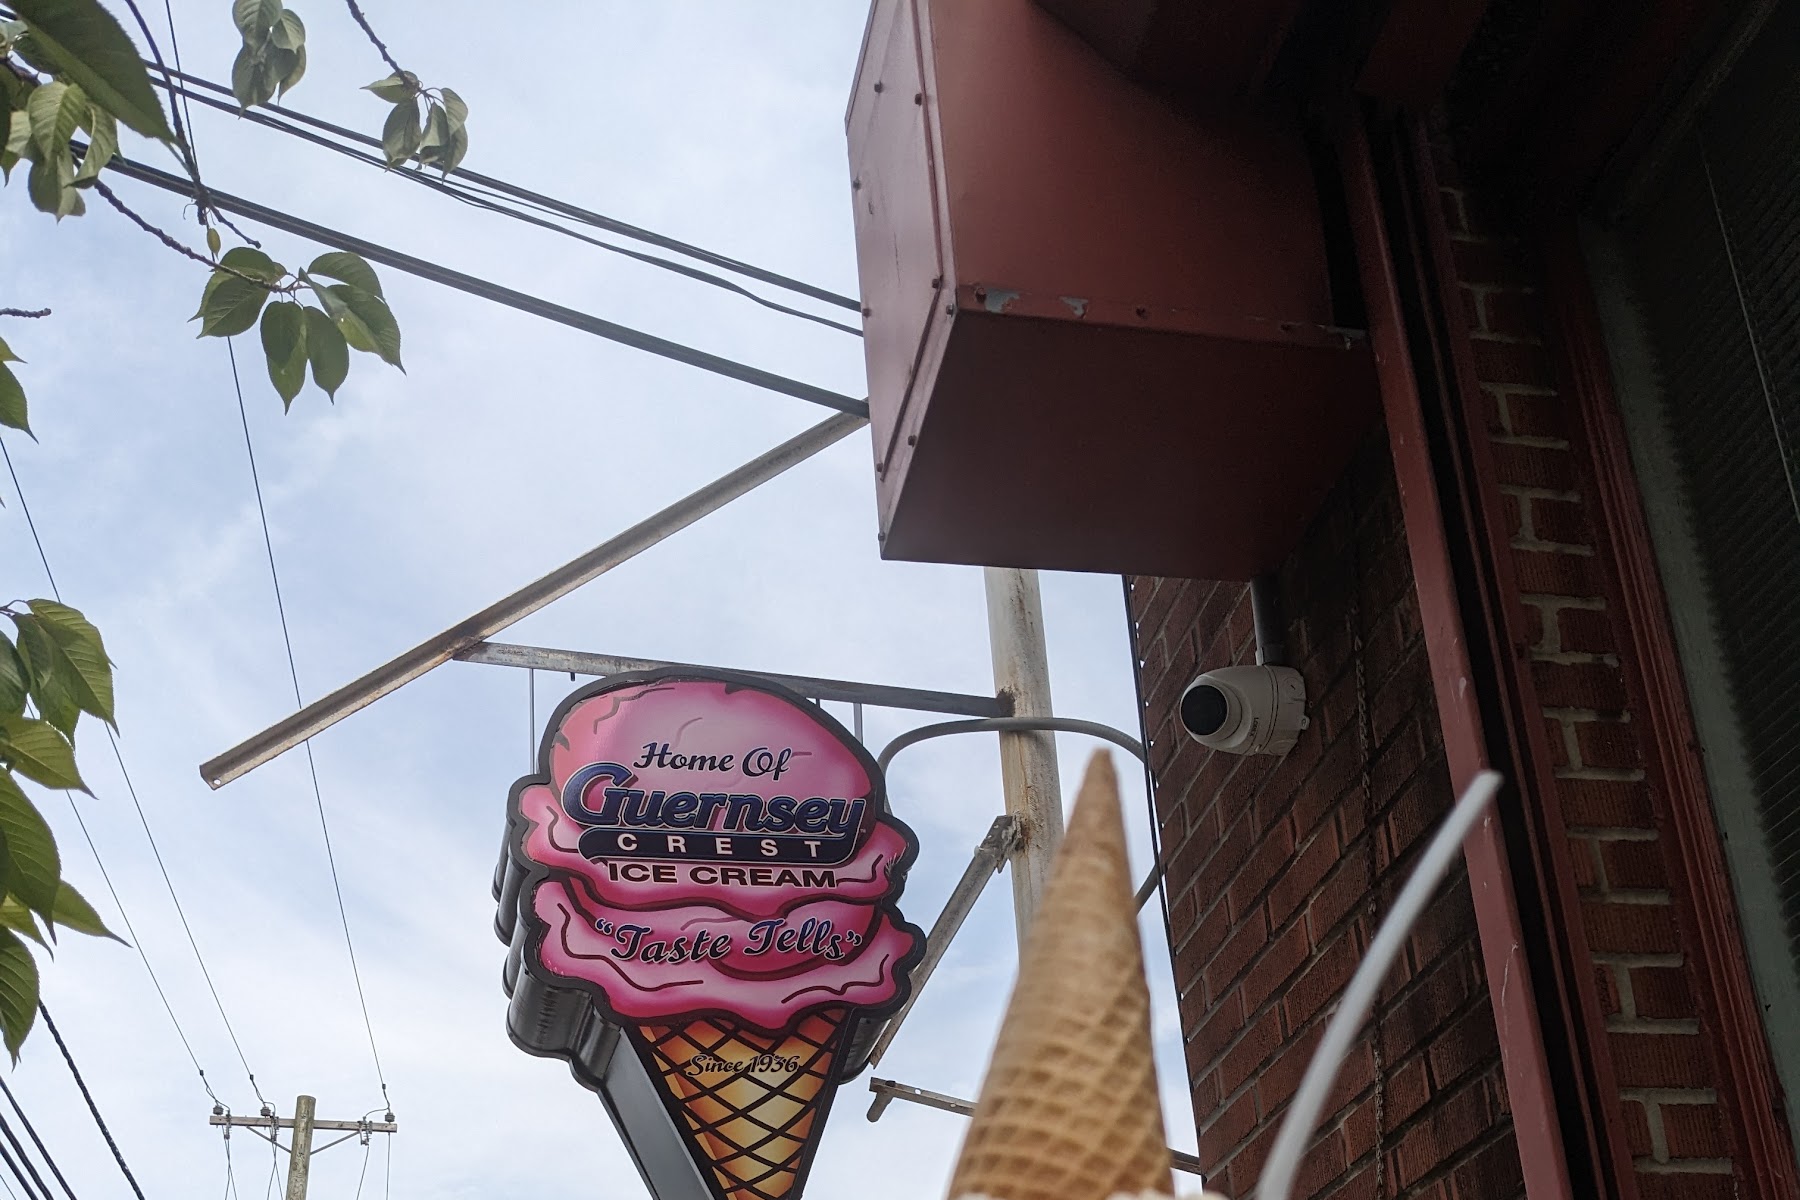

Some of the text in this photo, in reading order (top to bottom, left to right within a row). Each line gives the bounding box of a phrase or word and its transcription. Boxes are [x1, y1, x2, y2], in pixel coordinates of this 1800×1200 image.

[633, 741, 792, 781] Home Of
[561, 761, 866, 838] Guernsey
[617, 833, 821, 858] CREST
[608, 862, 838, 889] ICE CREAM
[686, 1053, 801, 1078] Since 1936
